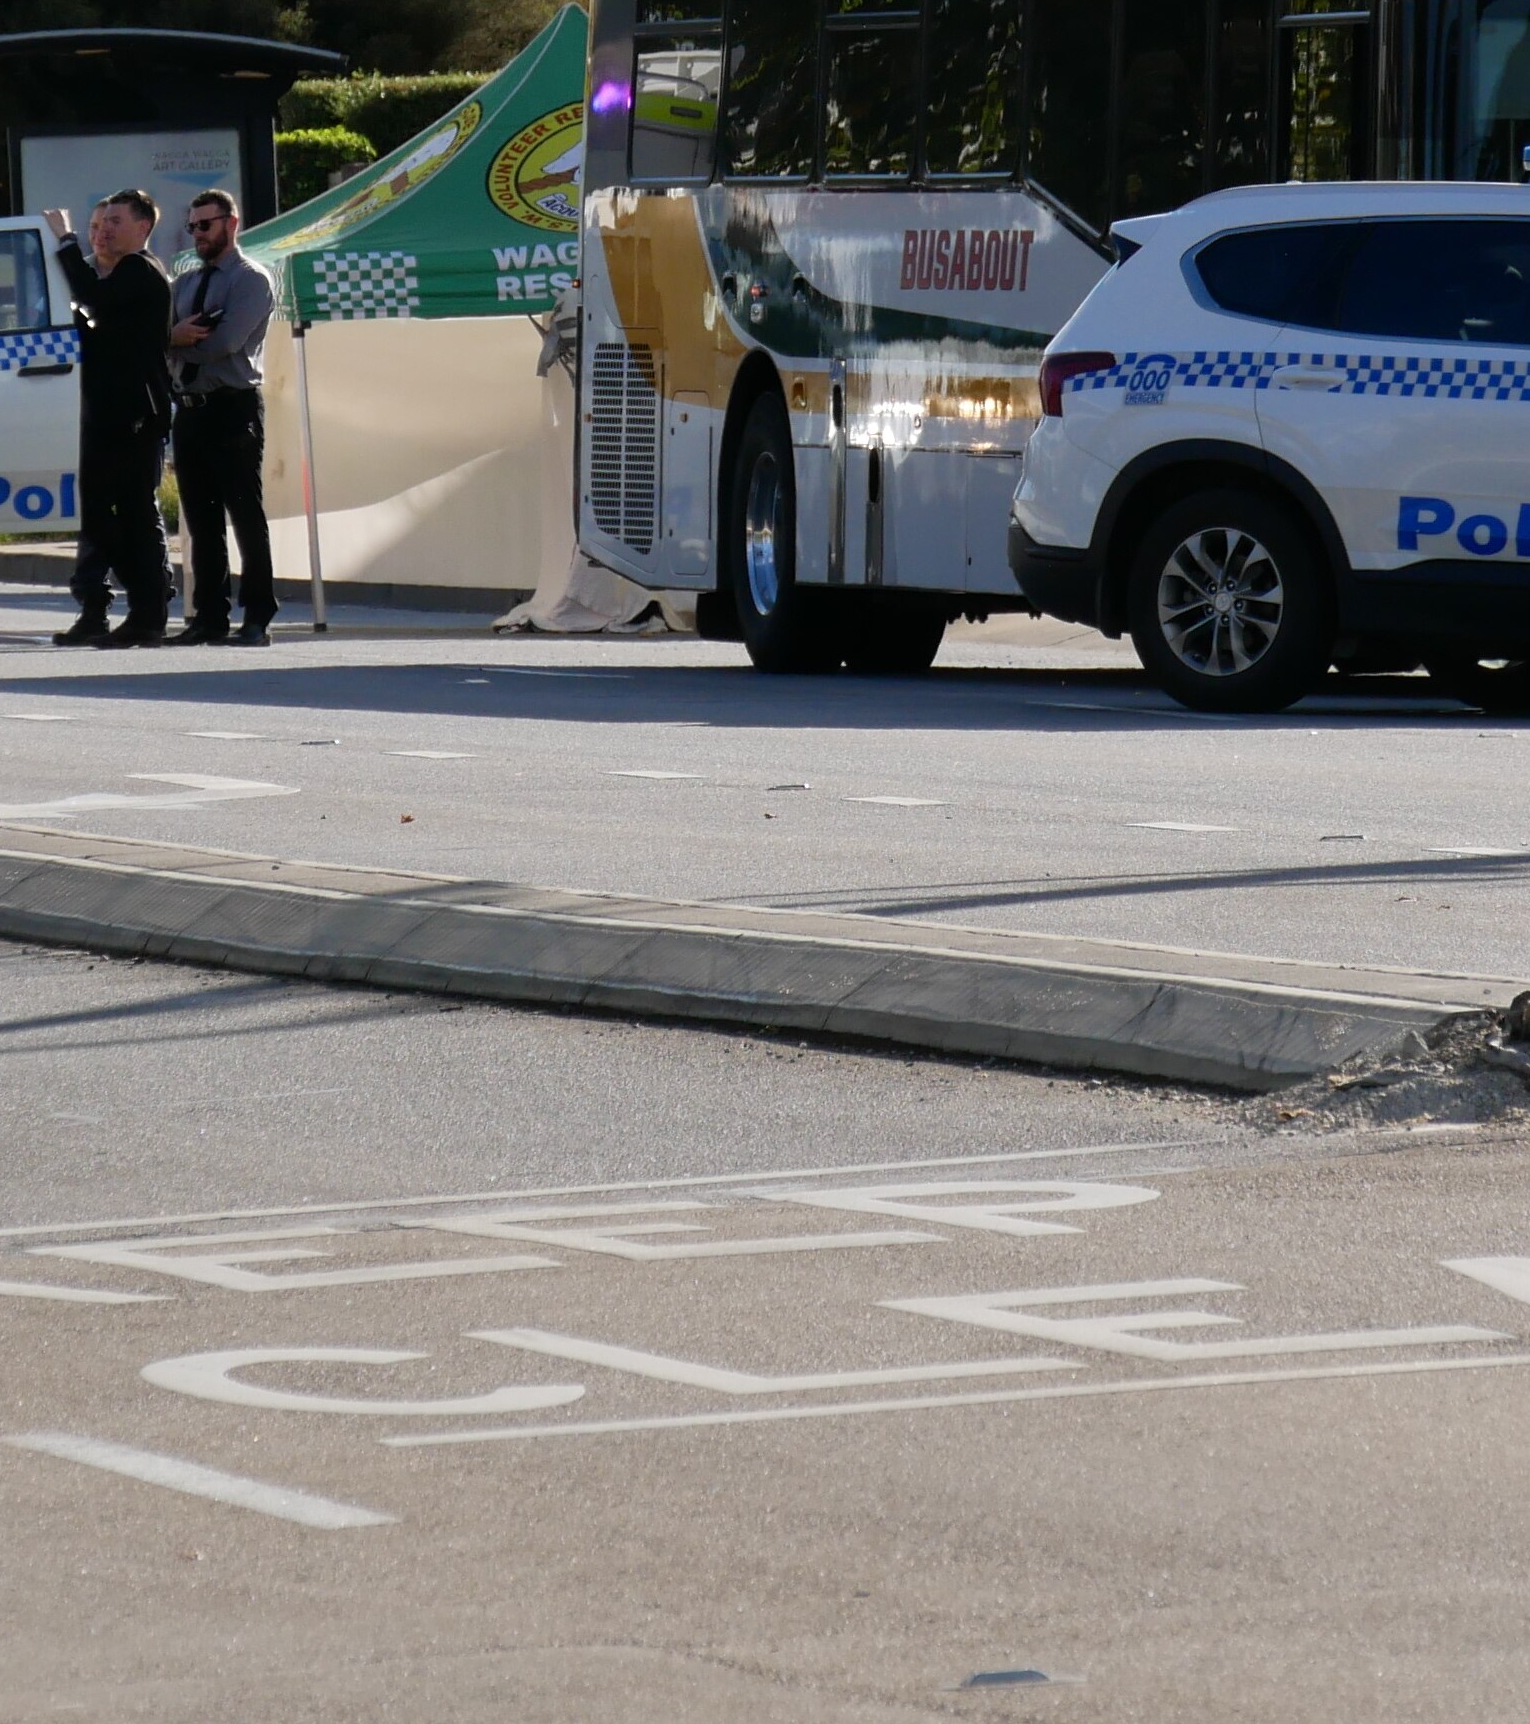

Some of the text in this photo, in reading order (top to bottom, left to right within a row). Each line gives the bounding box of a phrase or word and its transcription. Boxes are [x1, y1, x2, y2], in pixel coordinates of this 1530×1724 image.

[495, 123, 552, 211] VOLUNTEER
[492, 241, 579, 271] WAG
[900, 229, 1035, 292] BUSABOUT
[496, 272, 573, 302] RES
[1130, 370, 1171, 392] 000
[1125, 392, 1164, 405] EMERGENCY
